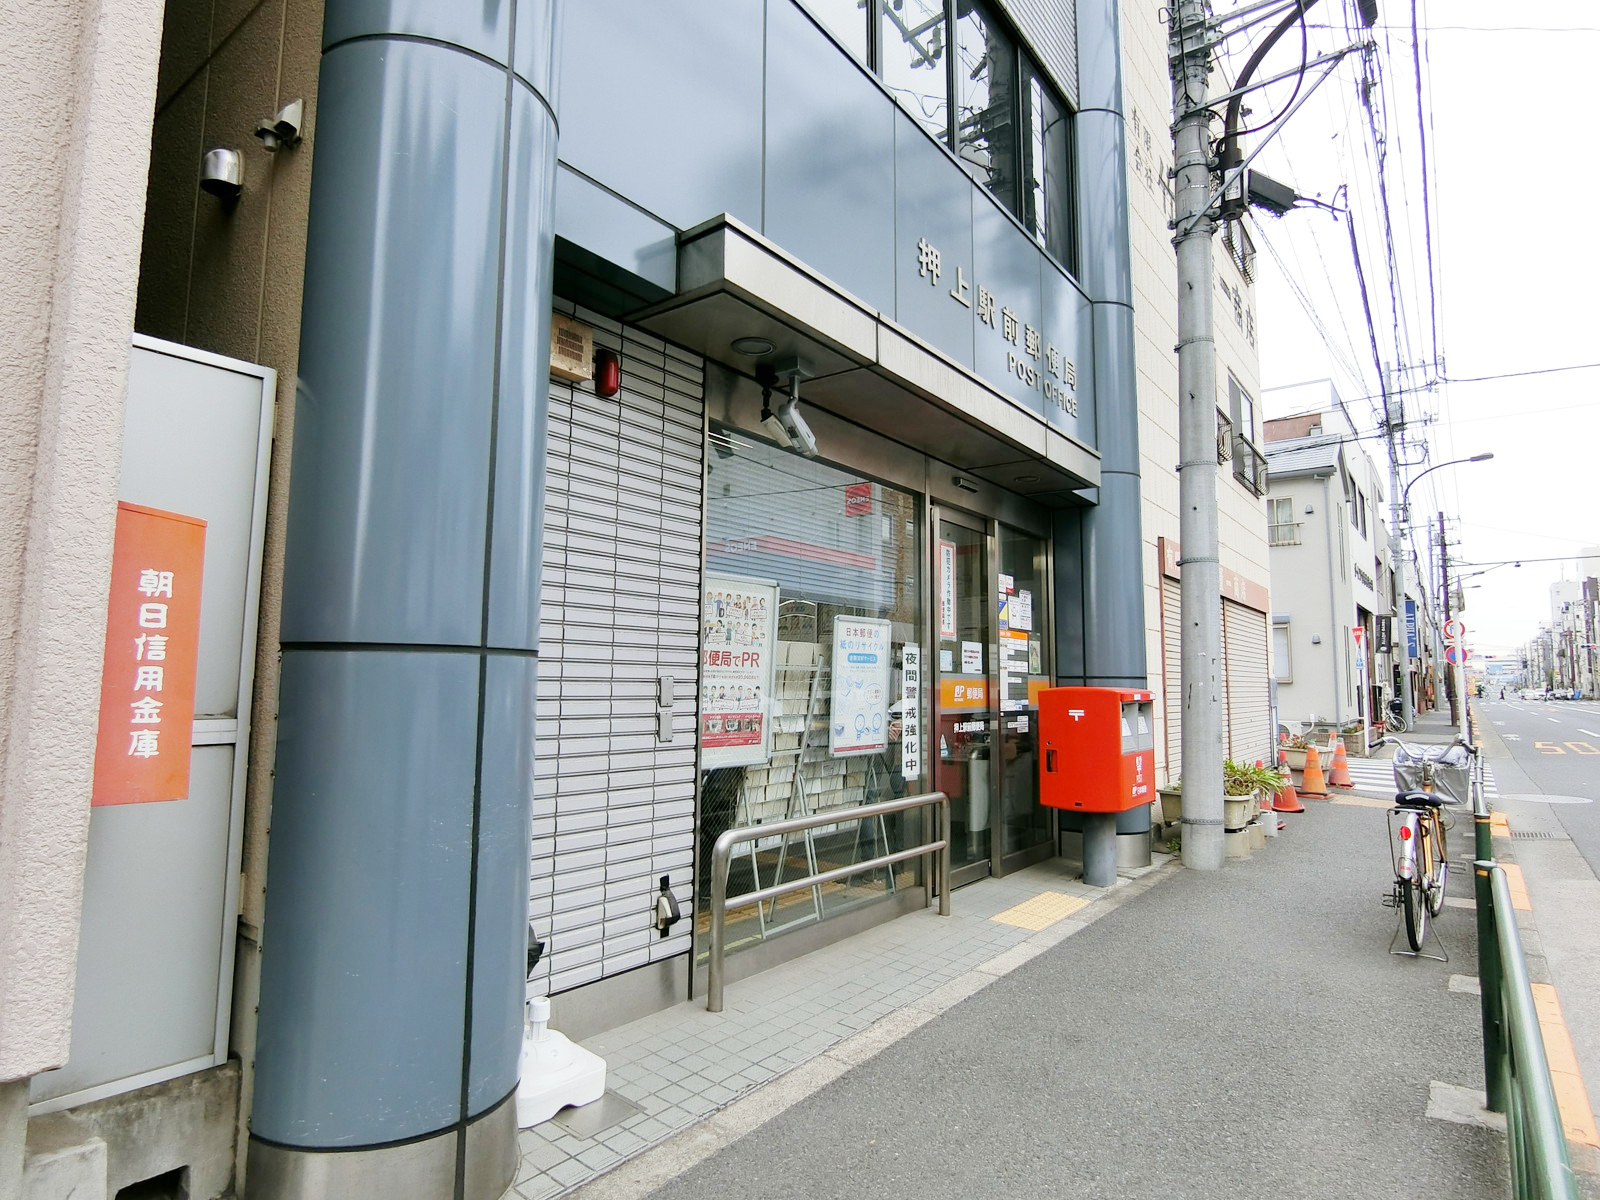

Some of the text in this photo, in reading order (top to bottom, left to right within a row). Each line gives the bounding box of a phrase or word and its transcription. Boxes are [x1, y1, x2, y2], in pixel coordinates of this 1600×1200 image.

[917, 236, 1078, 392] 押上駅前郵便局
[1007, 351, 1079, 419] POST OFFICE
[128, 568, 175, 759] 朝日信用金庫
[839, 639, 885, 651] 紙のリサイクル
[846, 627, 880, 639] 日本郵便の
[904, 652, 917, 772] 夜間警戒強化中
